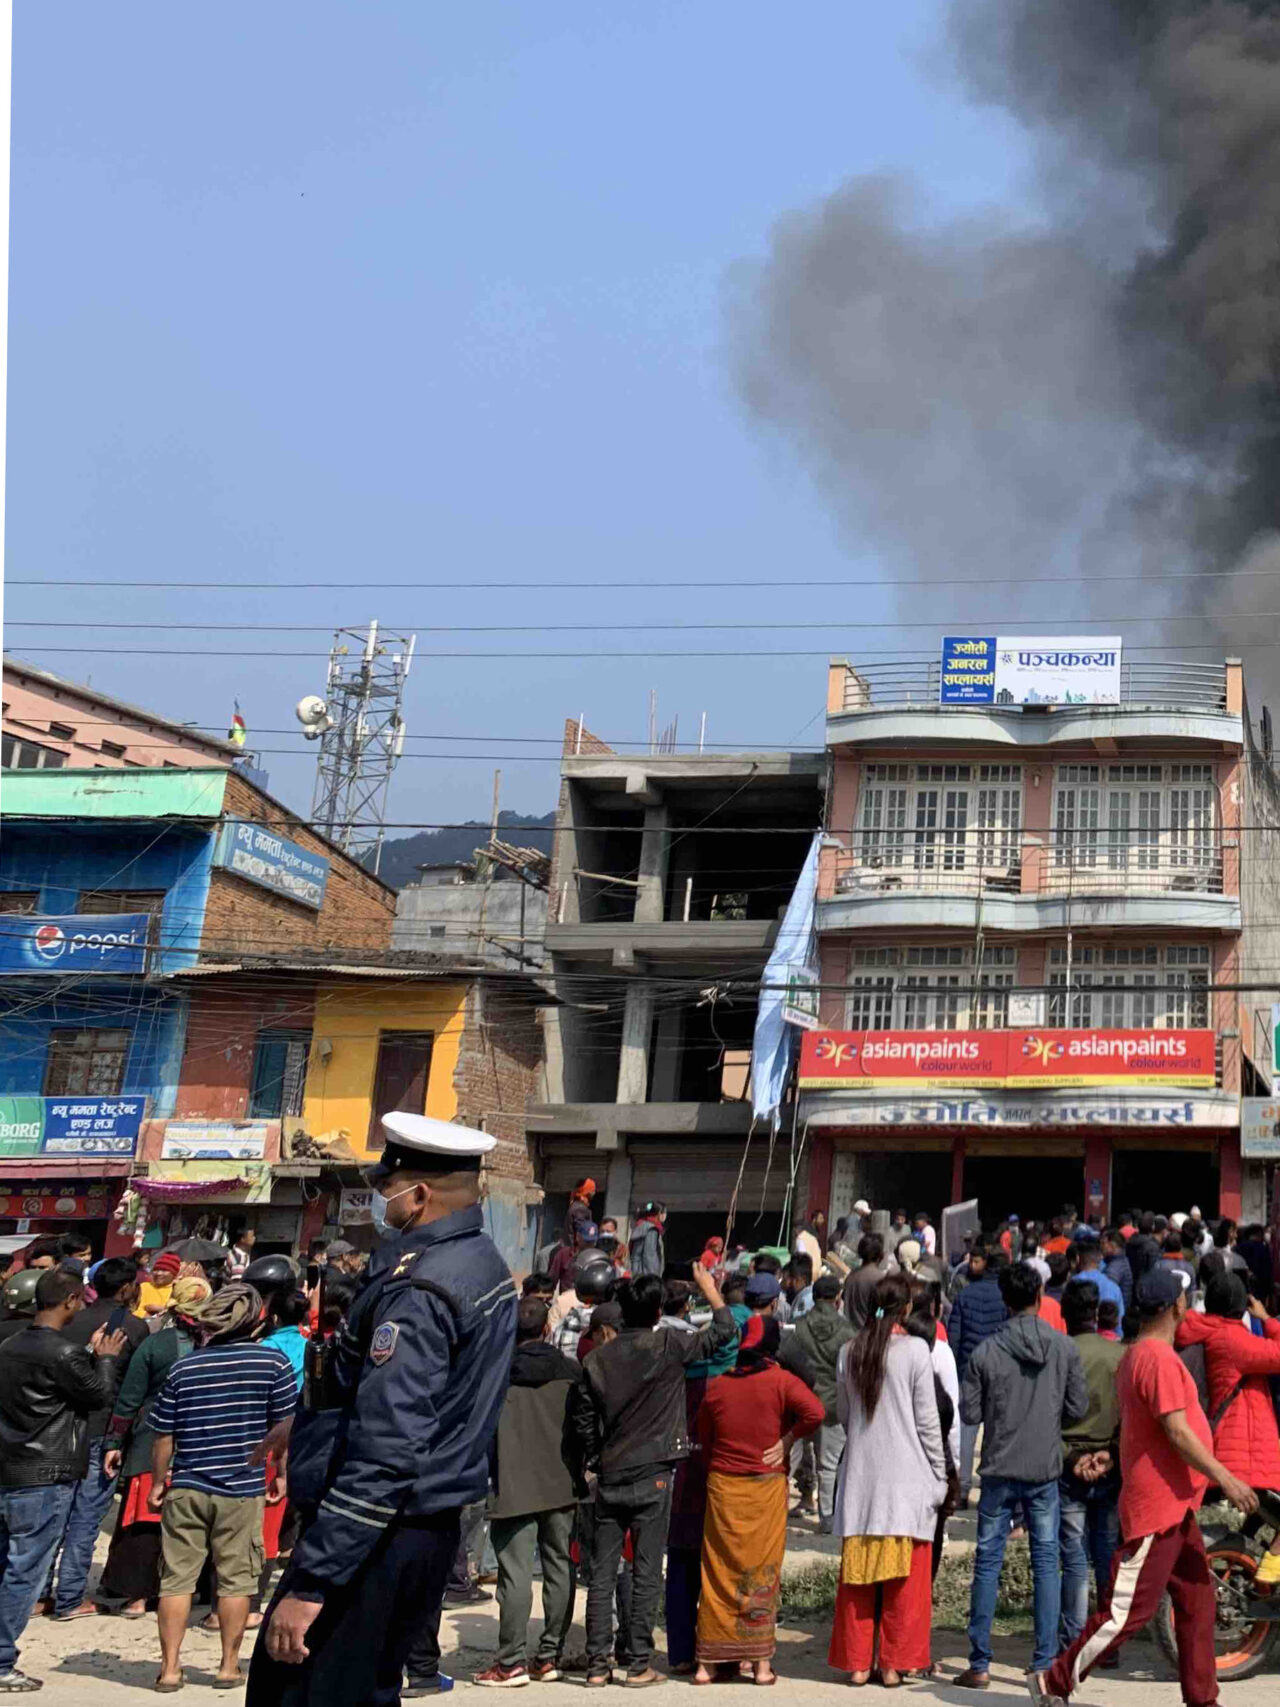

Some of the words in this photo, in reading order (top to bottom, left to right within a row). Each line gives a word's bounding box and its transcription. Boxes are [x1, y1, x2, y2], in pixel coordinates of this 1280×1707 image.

[947, 658, 988, 671] जनरल
[943, 672, 994, 686] सप्लायर्स
[70, 929, 136, 954] pepsi
[69, 1104, 98, 1116] ममता
[94, 1119, 115, 1130] लज
